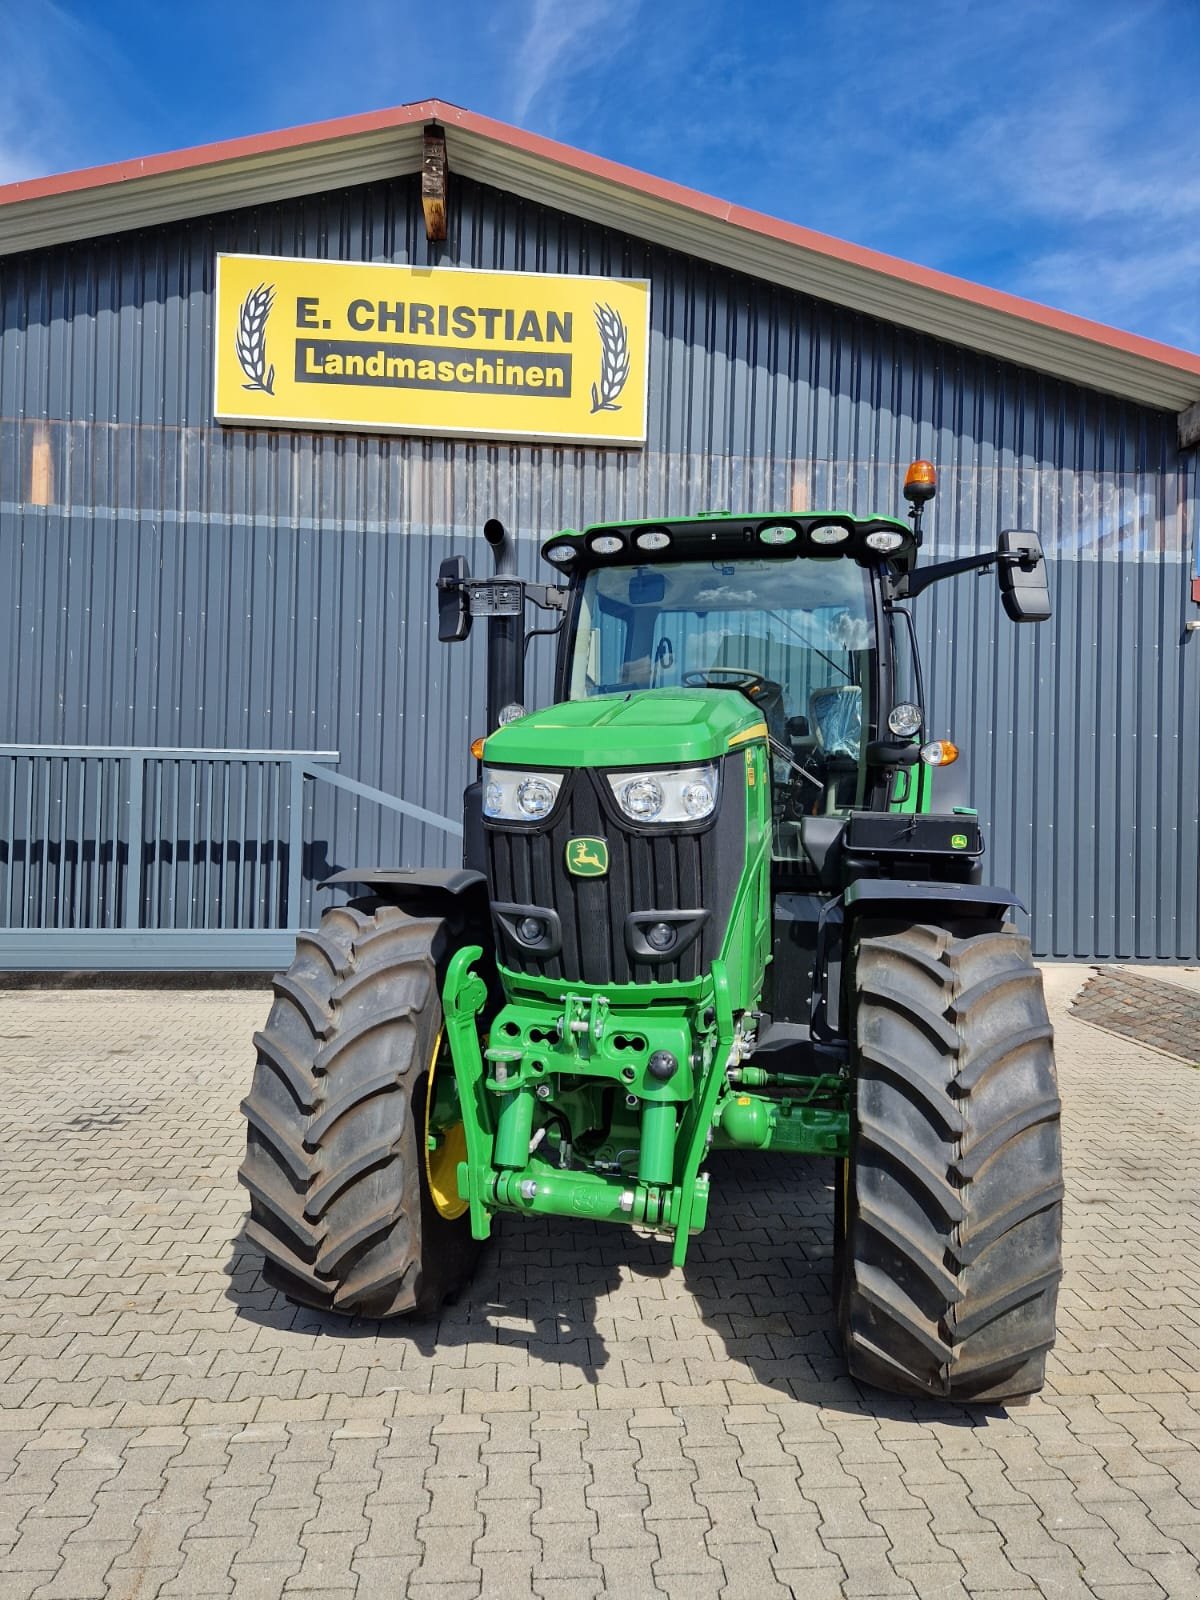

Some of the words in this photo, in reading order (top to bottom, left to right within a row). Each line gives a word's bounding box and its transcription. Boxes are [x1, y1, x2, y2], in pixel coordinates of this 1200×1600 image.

[296, 296, 331, 329] E.
[347, 299, 573, 343] CHRISTIAN
[305, 347, 564, 388] Landmaschinen
